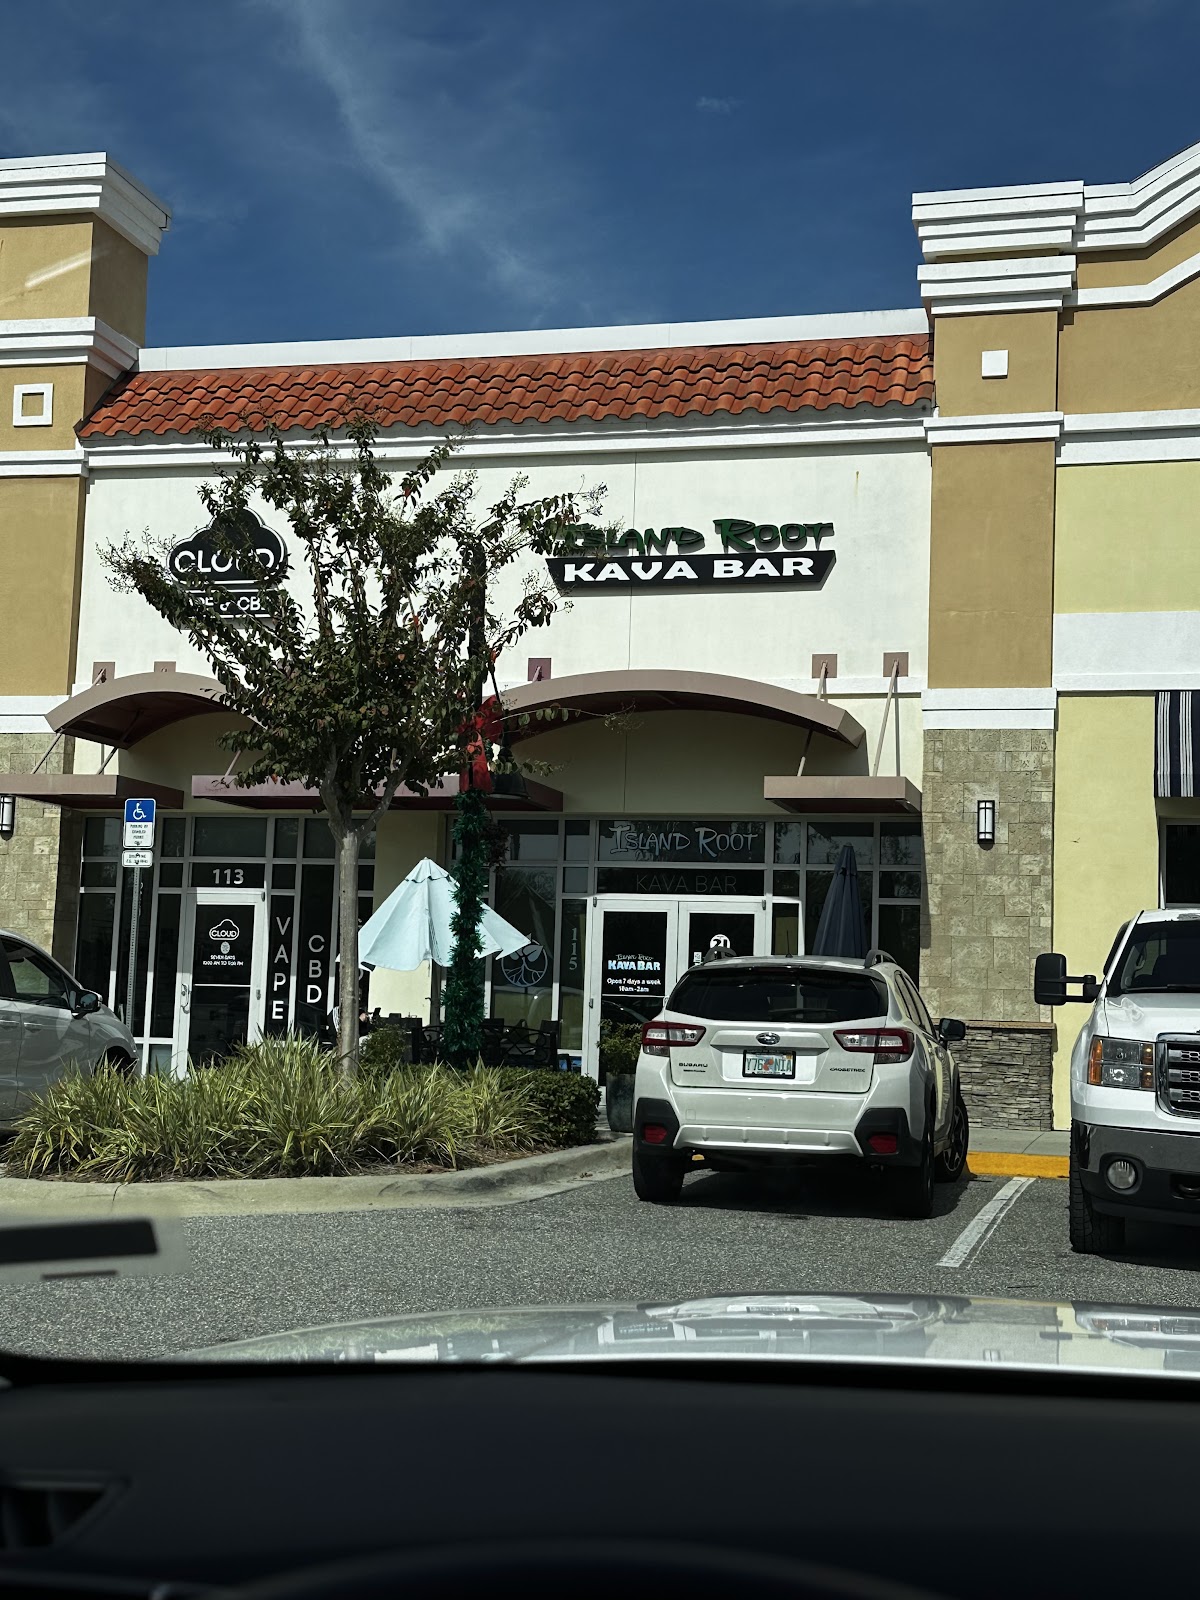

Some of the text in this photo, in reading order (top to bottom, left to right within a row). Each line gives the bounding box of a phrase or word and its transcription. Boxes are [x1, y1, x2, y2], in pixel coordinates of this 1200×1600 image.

[713, 518, 834, 552] ROOT
[563, 557, 815, 582] KAVA BAR
[608, 825, 759, 858] ISLAND ROOT
[212, 868, 244, 885] 113
[635, 874, 738, 893] KAVA BAR
[568, 927, 578, 971] 115
[607, 960, 661, 971] KAVA BAR
[271, 916, 291, 1020] VAPE
[306, 934, 326, 1004] CBD
